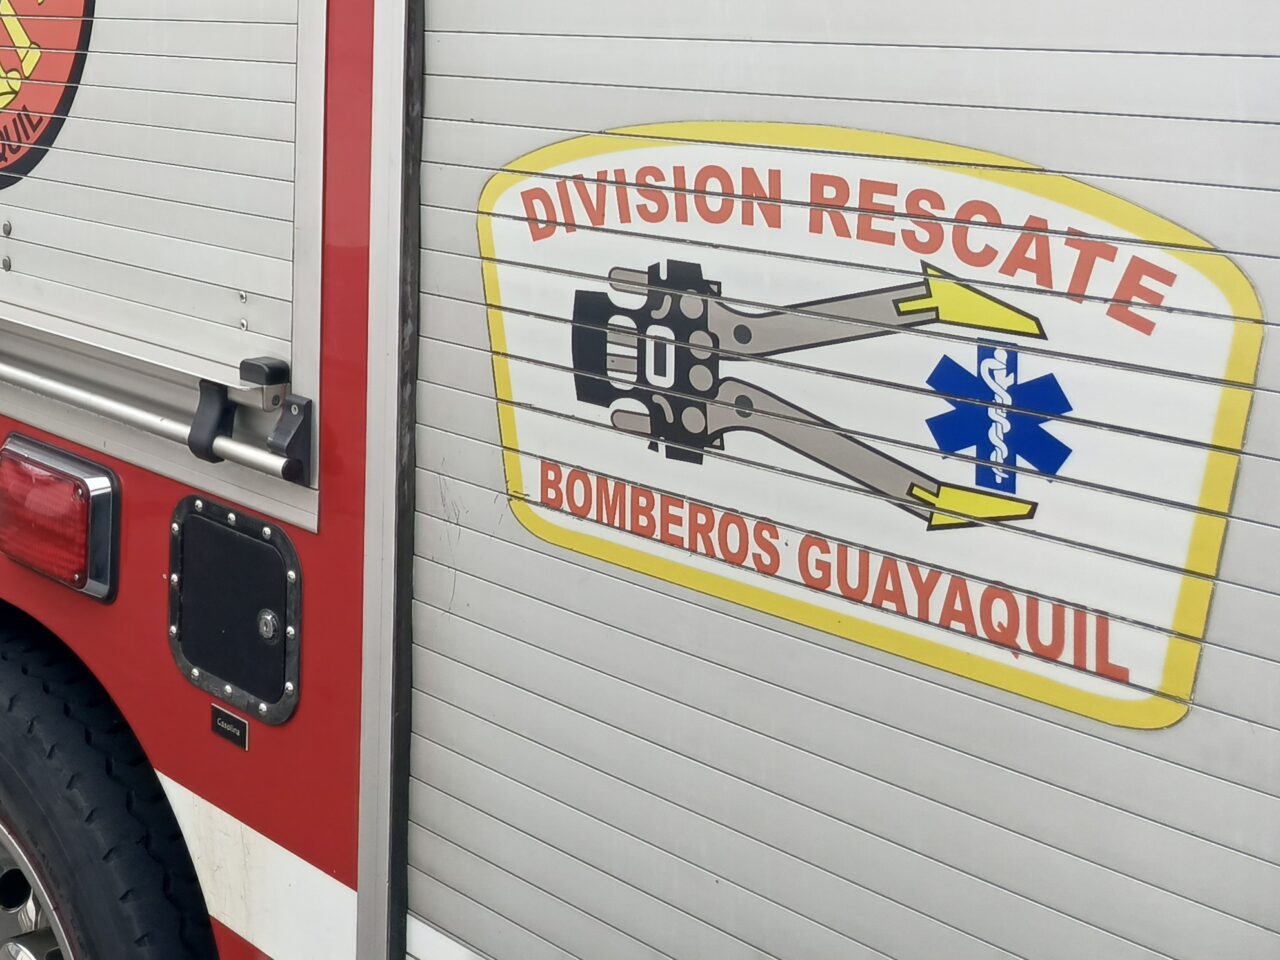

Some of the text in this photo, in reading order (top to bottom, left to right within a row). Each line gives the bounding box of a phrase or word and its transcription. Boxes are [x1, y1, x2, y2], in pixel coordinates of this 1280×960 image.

[520, 165, 1177, 336] DIVISION RESCATE
[539, 460, 1130, 684] BOMBEROS GUAYAQUIL
